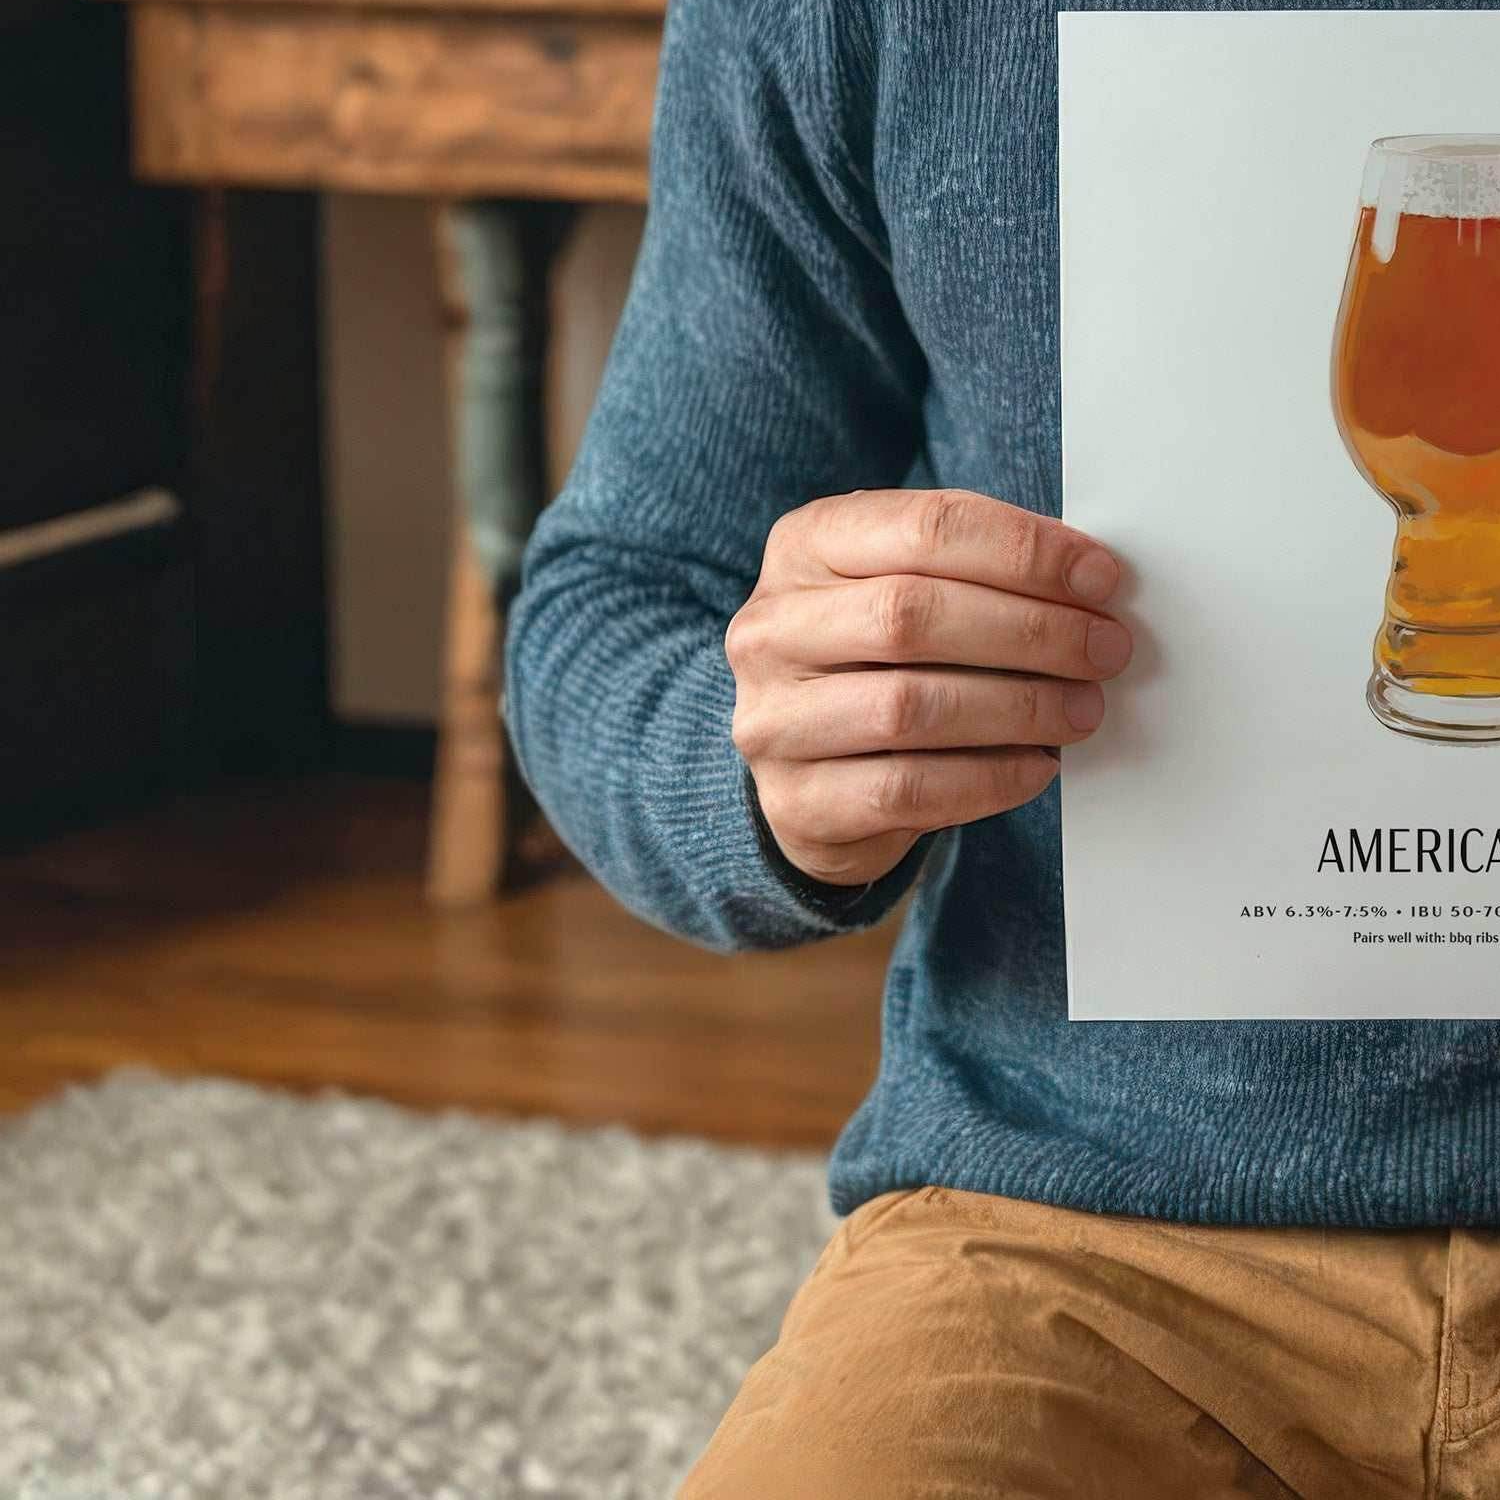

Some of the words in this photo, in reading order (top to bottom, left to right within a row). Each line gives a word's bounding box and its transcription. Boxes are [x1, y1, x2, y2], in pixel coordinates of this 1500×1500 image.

[1240, 905, 1278, 918] ABV
[1285, 905, 1388, 918] 6.3%-7.5%
[1410, 905, 1443, 918] IBU
[1353, 931, 1385, 944] Pairs
[1387, 931, 1412, 944] well
[1415, 931, 1446, 944] with:
[1449, 931, 1472, 946] bbq
[1475, 931, 1500, 944] ribs
